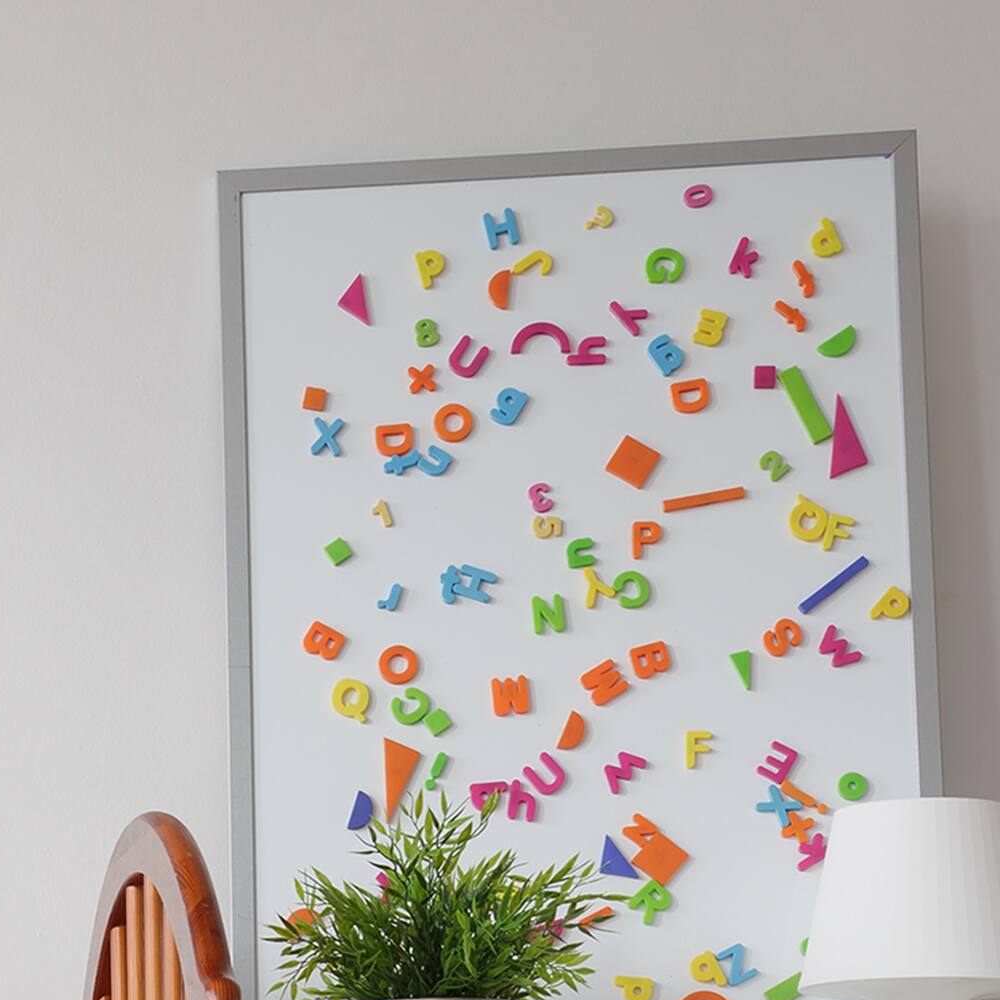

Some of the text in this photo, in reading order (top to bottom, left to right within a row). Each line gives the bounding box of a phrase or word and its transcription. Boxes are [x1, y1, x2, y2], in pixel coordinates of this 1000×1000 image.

[483, 207, 520, 251] H
[631, 520, 664, 560] P
[823, 513, 856, 551] F
[532, 593, 566, 635] N
[303, 620, 346, 662] B
[628, 640, 672, 681] B
[331, 678, 371, 724] Q
[684, 730, 713, 769] F
[628, 879, 673, 926] R
